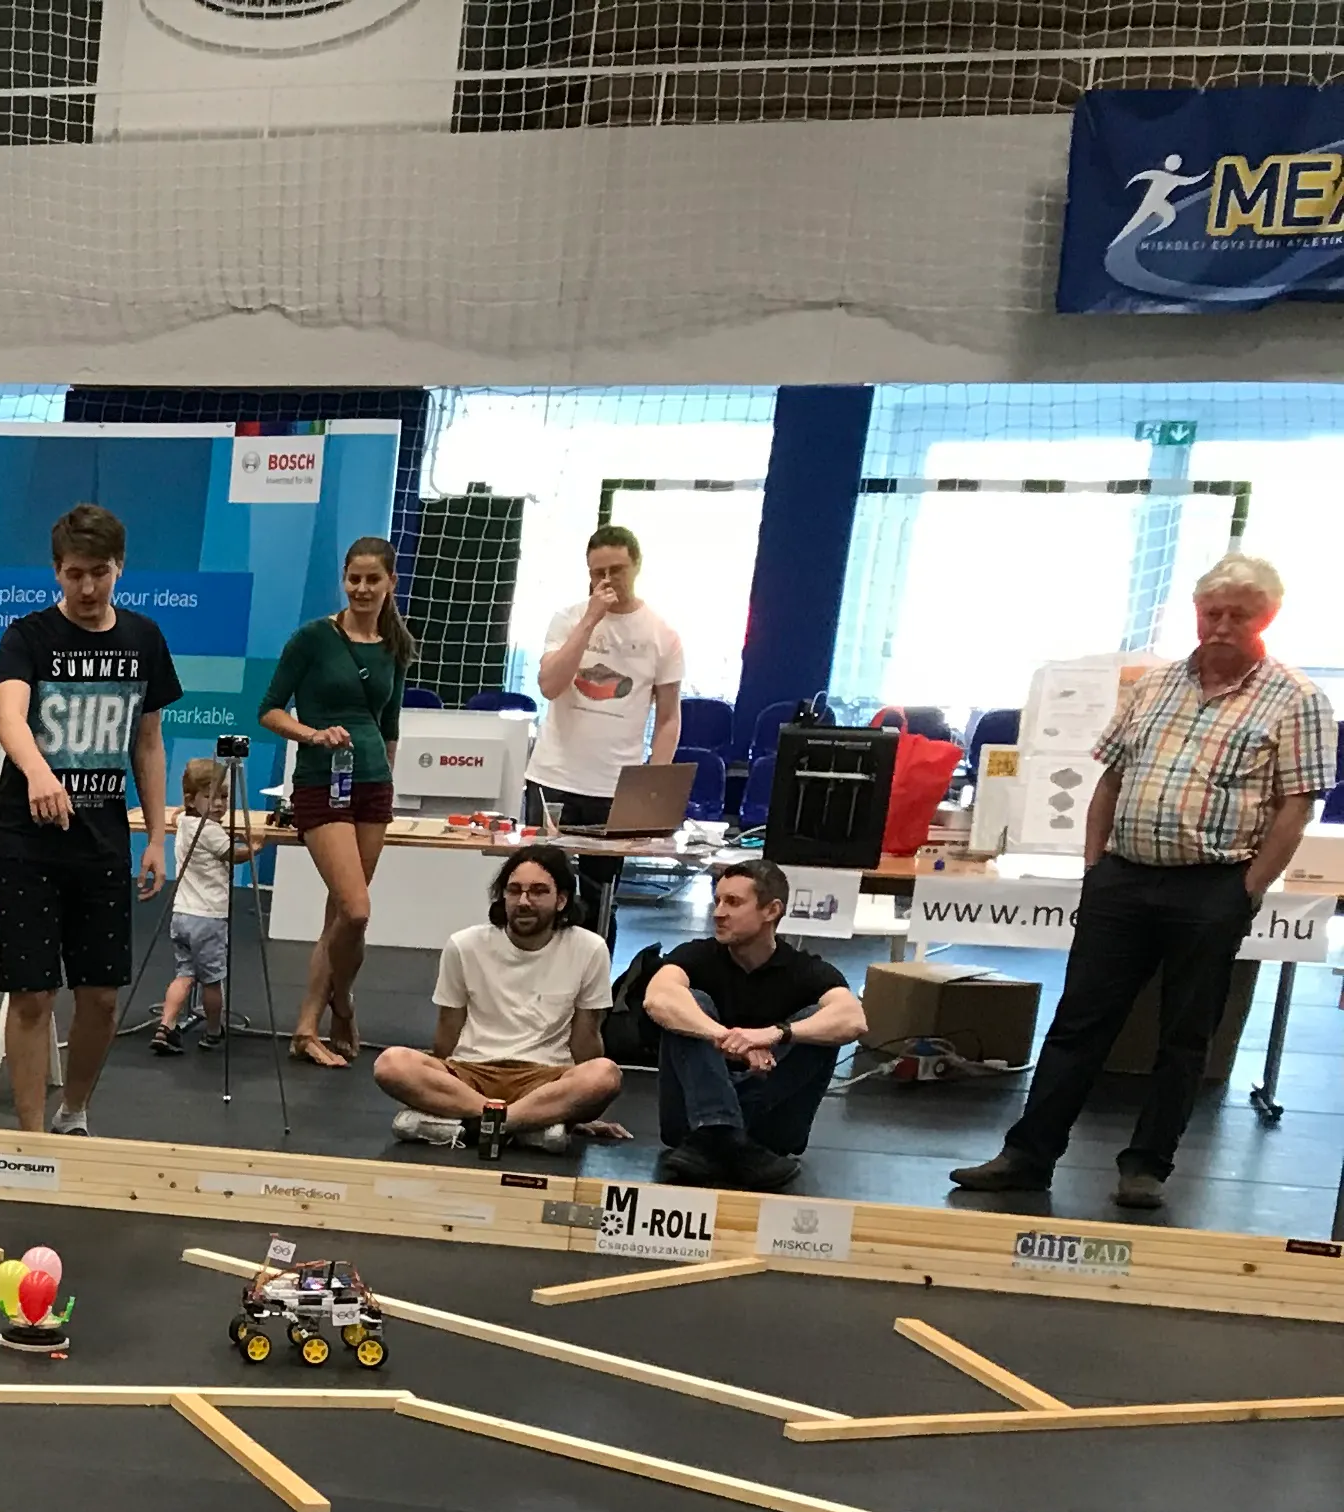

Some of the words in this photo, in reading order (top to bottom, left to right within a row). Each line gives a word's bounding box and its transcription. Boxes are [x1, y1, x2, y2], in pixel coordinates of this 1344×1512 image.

[267, 453, 316, 471] BOSCH
[153, 588, 199, 607] ideas
[51, 657, 140, 678] SUMMER
[162, 706, 238, 726] markable.
[439, 755, 484, 767] BOSCH
[264, 1183, 341, 1201] MeetEdison
[601, 1185, 712, 1241] M-ROLL
[772, 1238, 834, 1253] MISKOLCI
[1016, 1233, 1131, 1265] chipCAD
